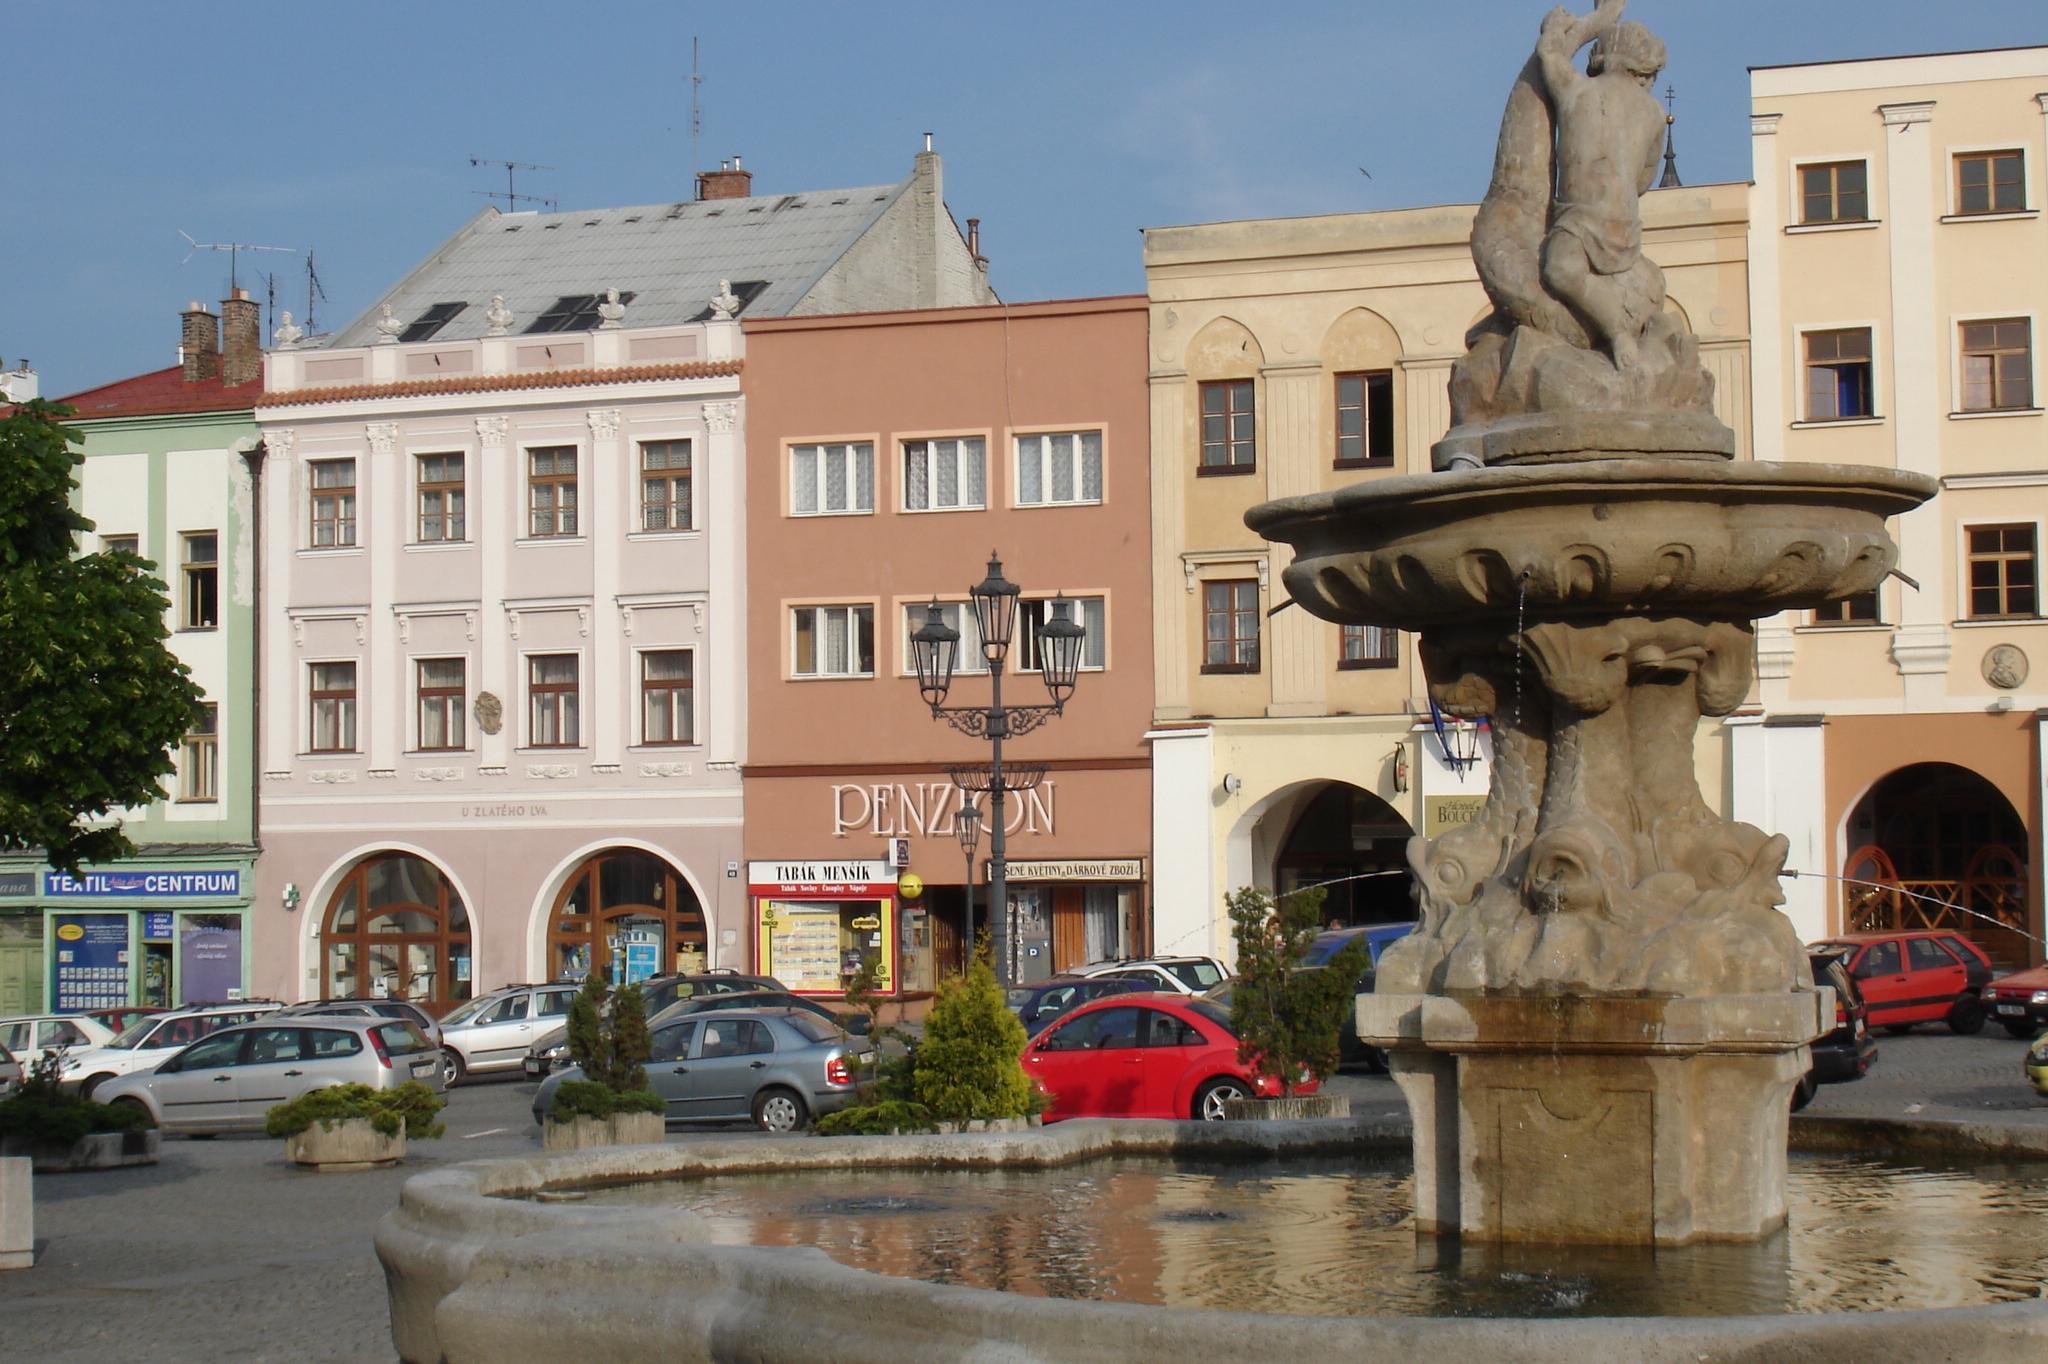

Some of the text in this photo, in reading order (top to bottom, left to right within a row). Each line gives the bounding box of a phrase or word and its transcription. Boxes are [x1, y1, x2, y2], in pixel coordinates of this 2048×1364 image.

[474, 804, 525, 817] ZLATÉHO
[530, 805, 548, 817] LVA
[776, 861, 870, 881] TABÁK MENŠÍK
[1028, 863, 1061, 876] KVĚTINY
[1066, 863, 1106, 876] DÁRKOVÉ
[1110, 862, 1134, 876] ZBOŽÍ
[49, 875, 112, 892] TEXTIL
[144, 874, 236, 892] CENTRUM
